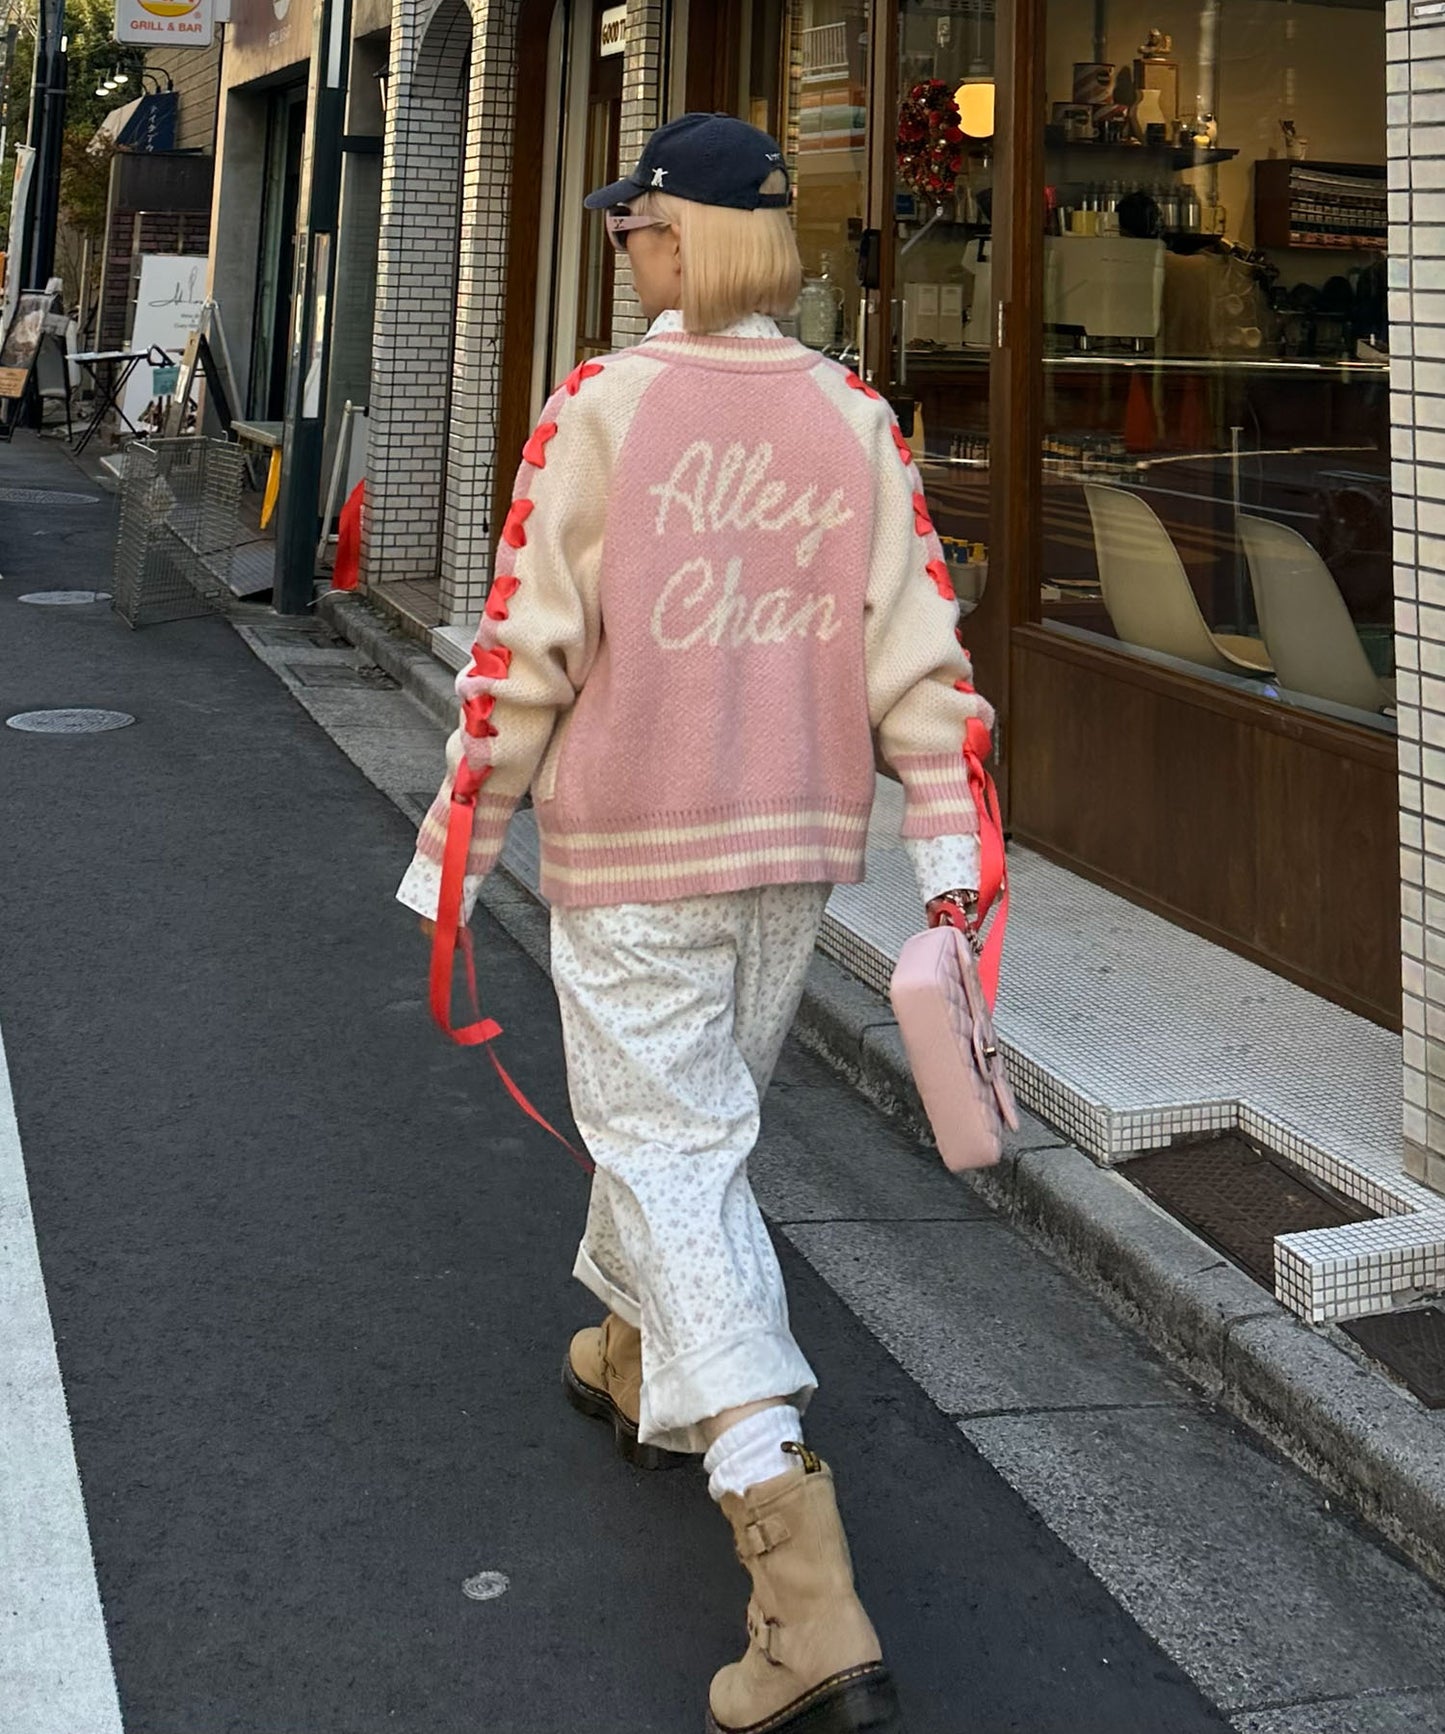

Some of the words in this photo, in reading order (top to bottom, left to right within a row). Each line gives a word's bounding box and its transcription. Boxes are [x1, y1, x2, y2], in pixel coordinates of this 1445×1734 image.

[130, 20, 164, 31] GRILL
[167, 22, 175, 31] &
[178, 22, 202, 32] BAR
[602, 21, 620, 45] GOOD
[649, 440, 854, 568] Alley
[652, 556, 842, 651] Chan
